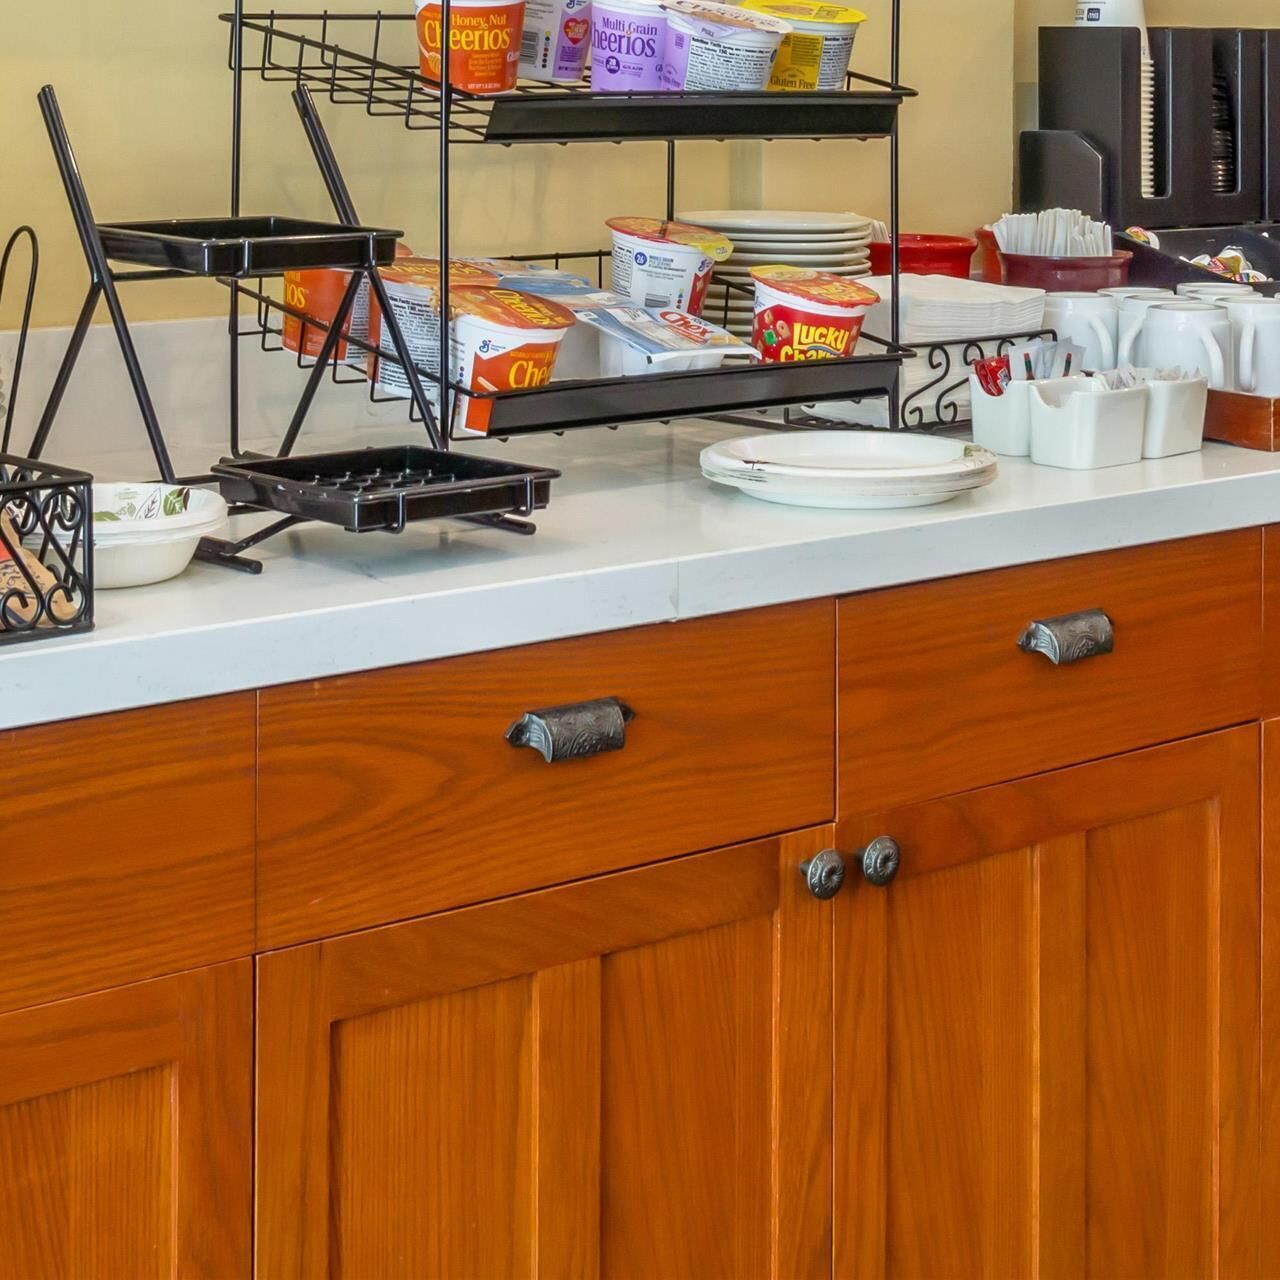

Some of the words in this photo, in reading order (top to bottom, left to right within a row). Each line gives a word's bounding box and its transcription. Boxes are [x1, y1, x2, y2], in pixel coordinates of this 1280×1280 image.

[451, 14, 487, 30] Honey
[489, 14, 507, 25] Nut
[602, 17, 625, 32] Multi
[628, 21, 658, 36] Grain
[592, 21, 656, 58] heerios
[798, 77, 816, 90] Free
[792, 322, 850, 354] Lucky
